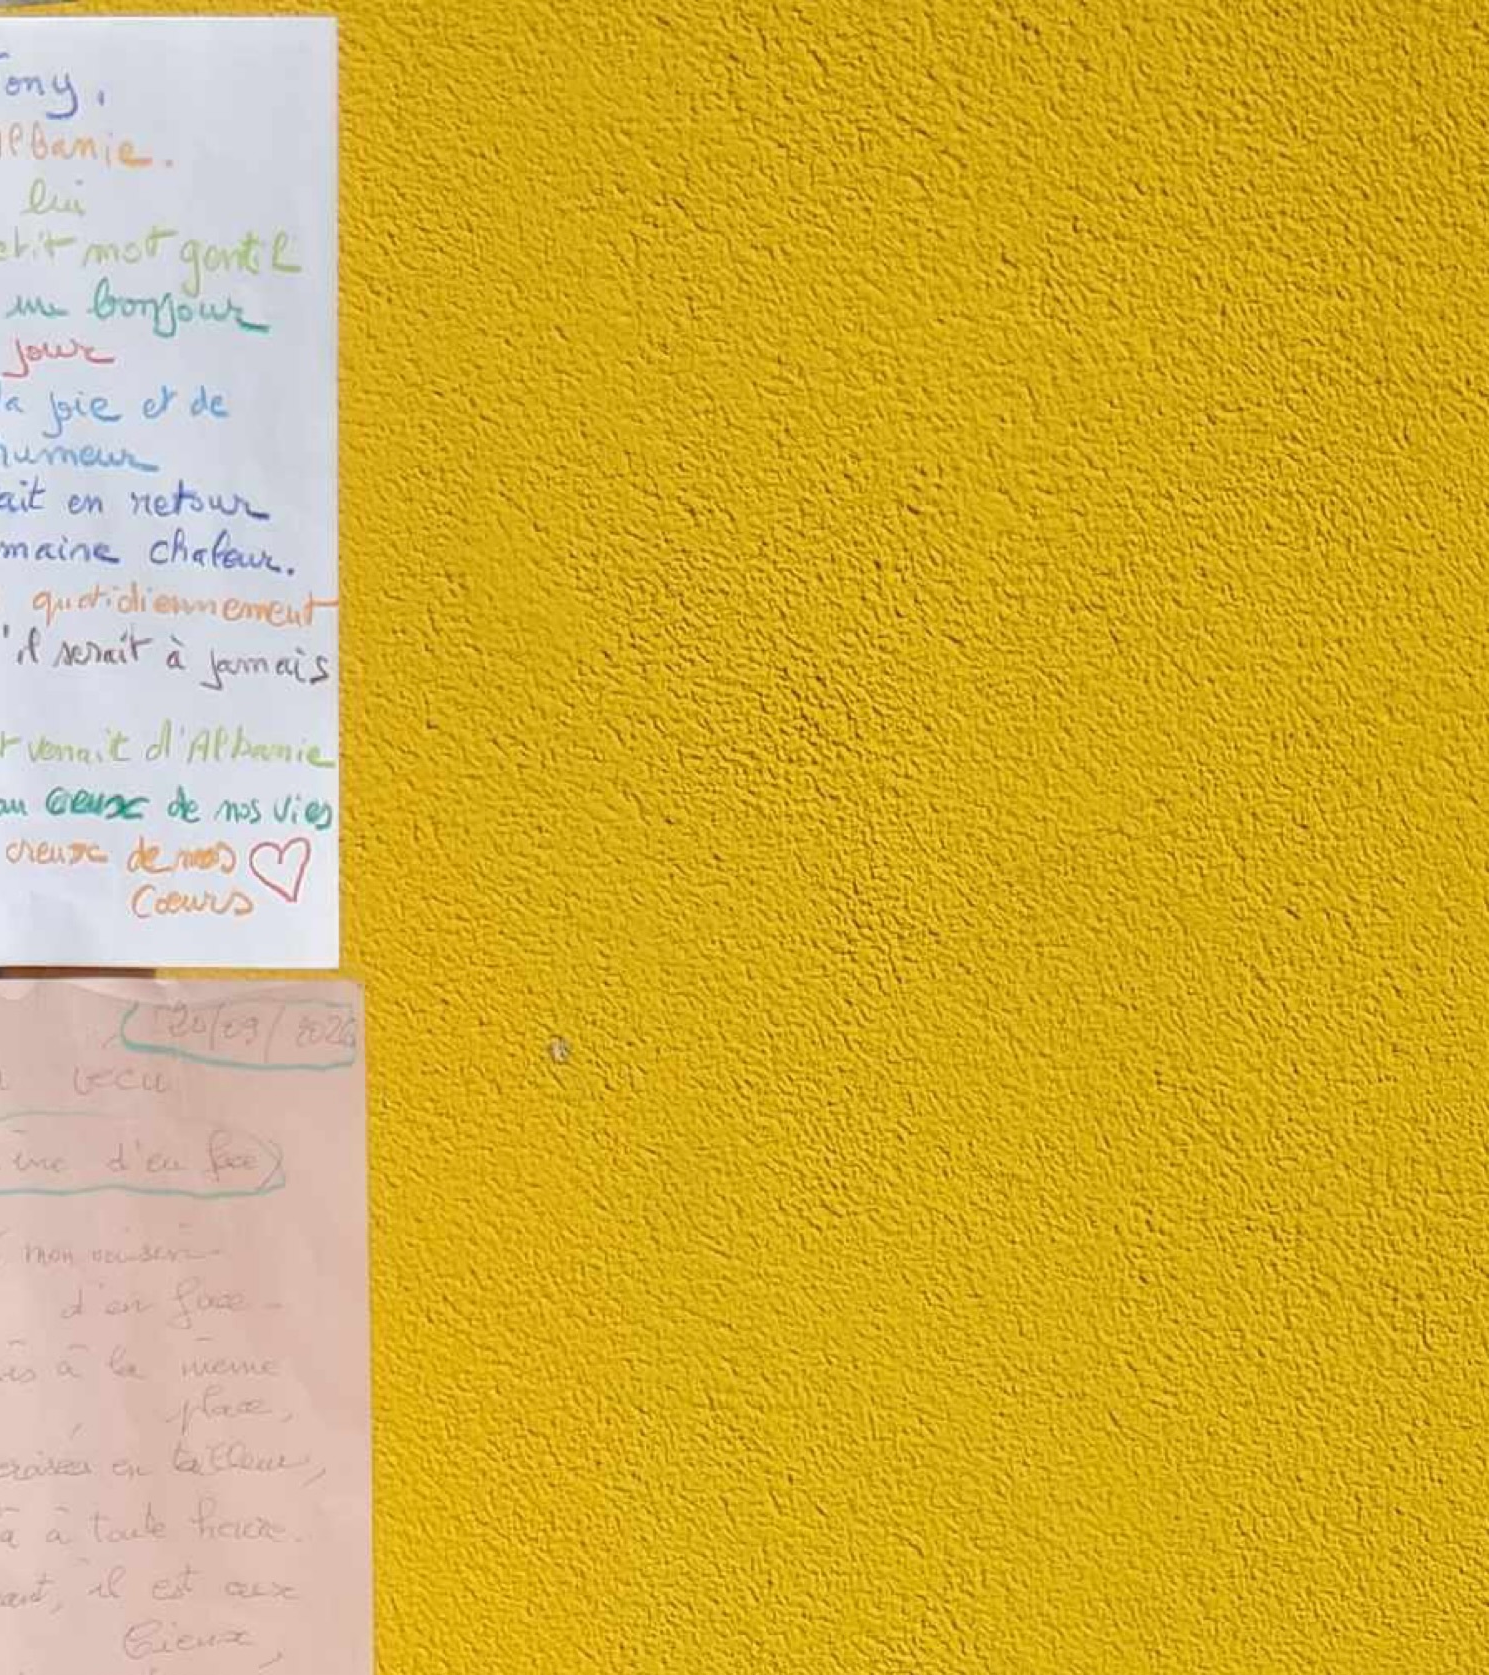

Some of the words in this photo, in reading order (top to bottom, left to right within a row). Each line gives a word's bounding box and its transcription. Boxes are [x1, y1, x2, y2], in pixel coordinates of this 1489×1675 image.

[21, 179, 86, 214] lui
[89, 276, 269, 338] bonjour
[3, 338, 116, 379] jour
[43, 393, 123, 439] joie
[143, 386, 177, 421] et
[192, 386, 230, 419] de
[66, 492, 104, 516] en
[132, 480, 270, 521] retour
[166, 635, 186, 672] à
[201, 645, 333, 689] jamais
[167, 785, 202, 824] de
[274, 787, 333, 831] vies
